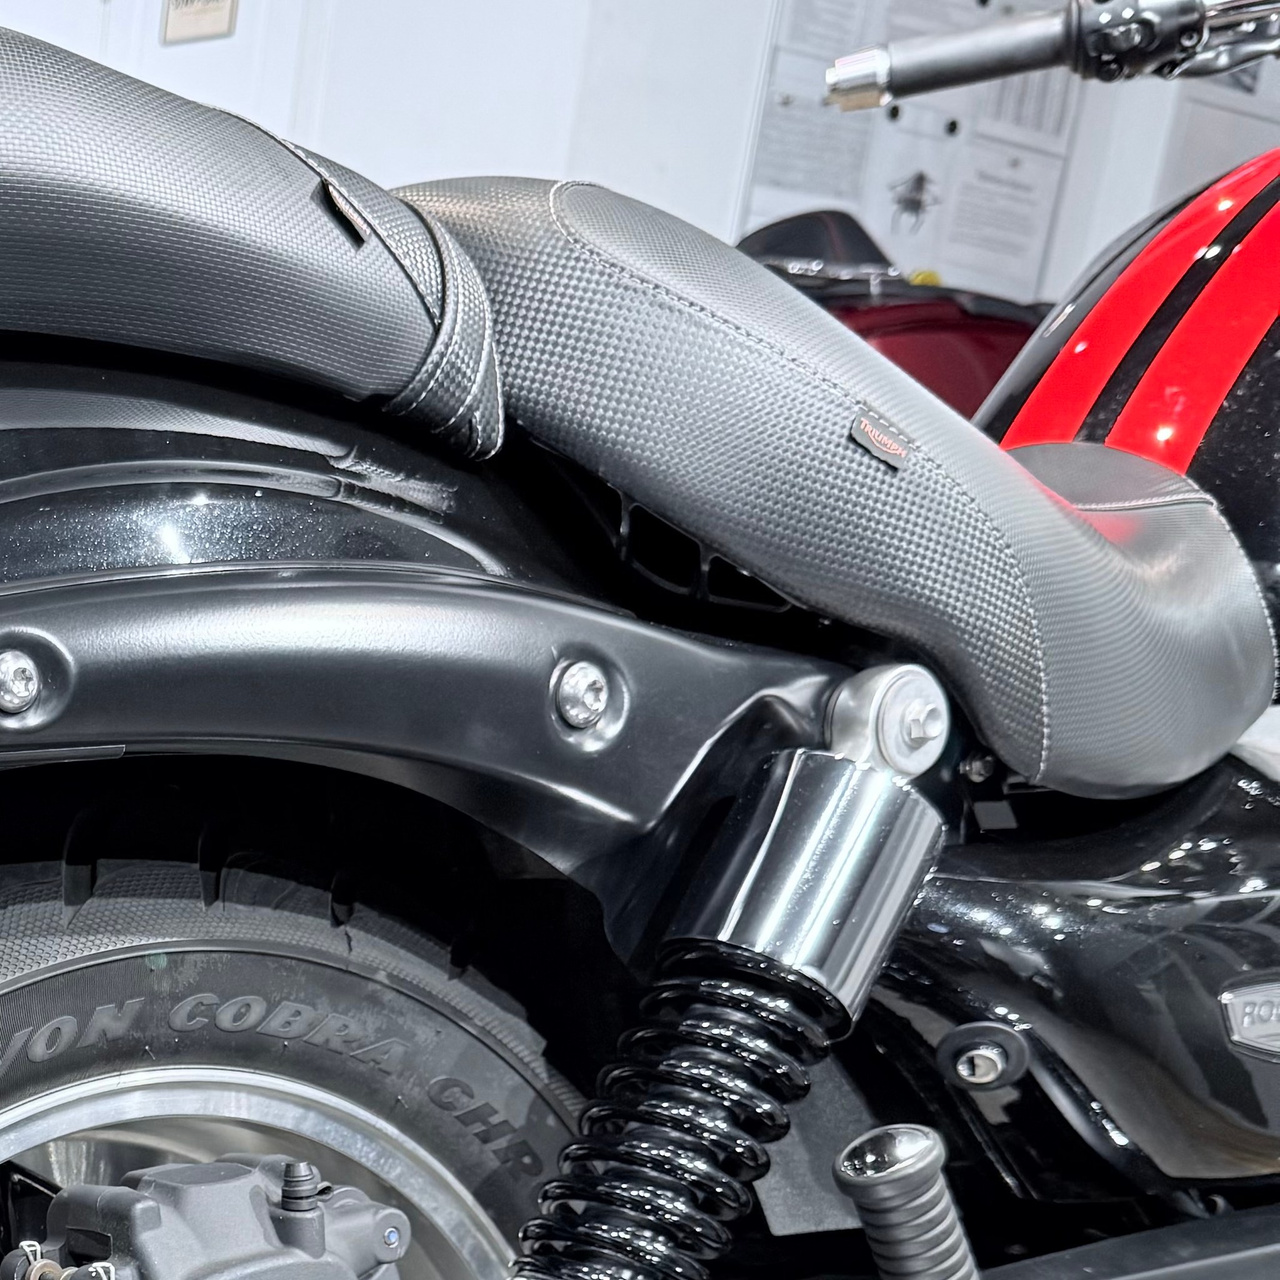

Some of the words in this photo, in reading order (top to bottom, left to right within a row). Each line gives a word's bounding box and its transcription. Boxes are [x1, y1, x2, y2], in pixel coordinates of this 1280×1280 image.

[860, 416, 907, 458] TRIUMPH
[168, 993, 410, 1075] COBRA
[1241, 1001, 1280, 1028] RO
